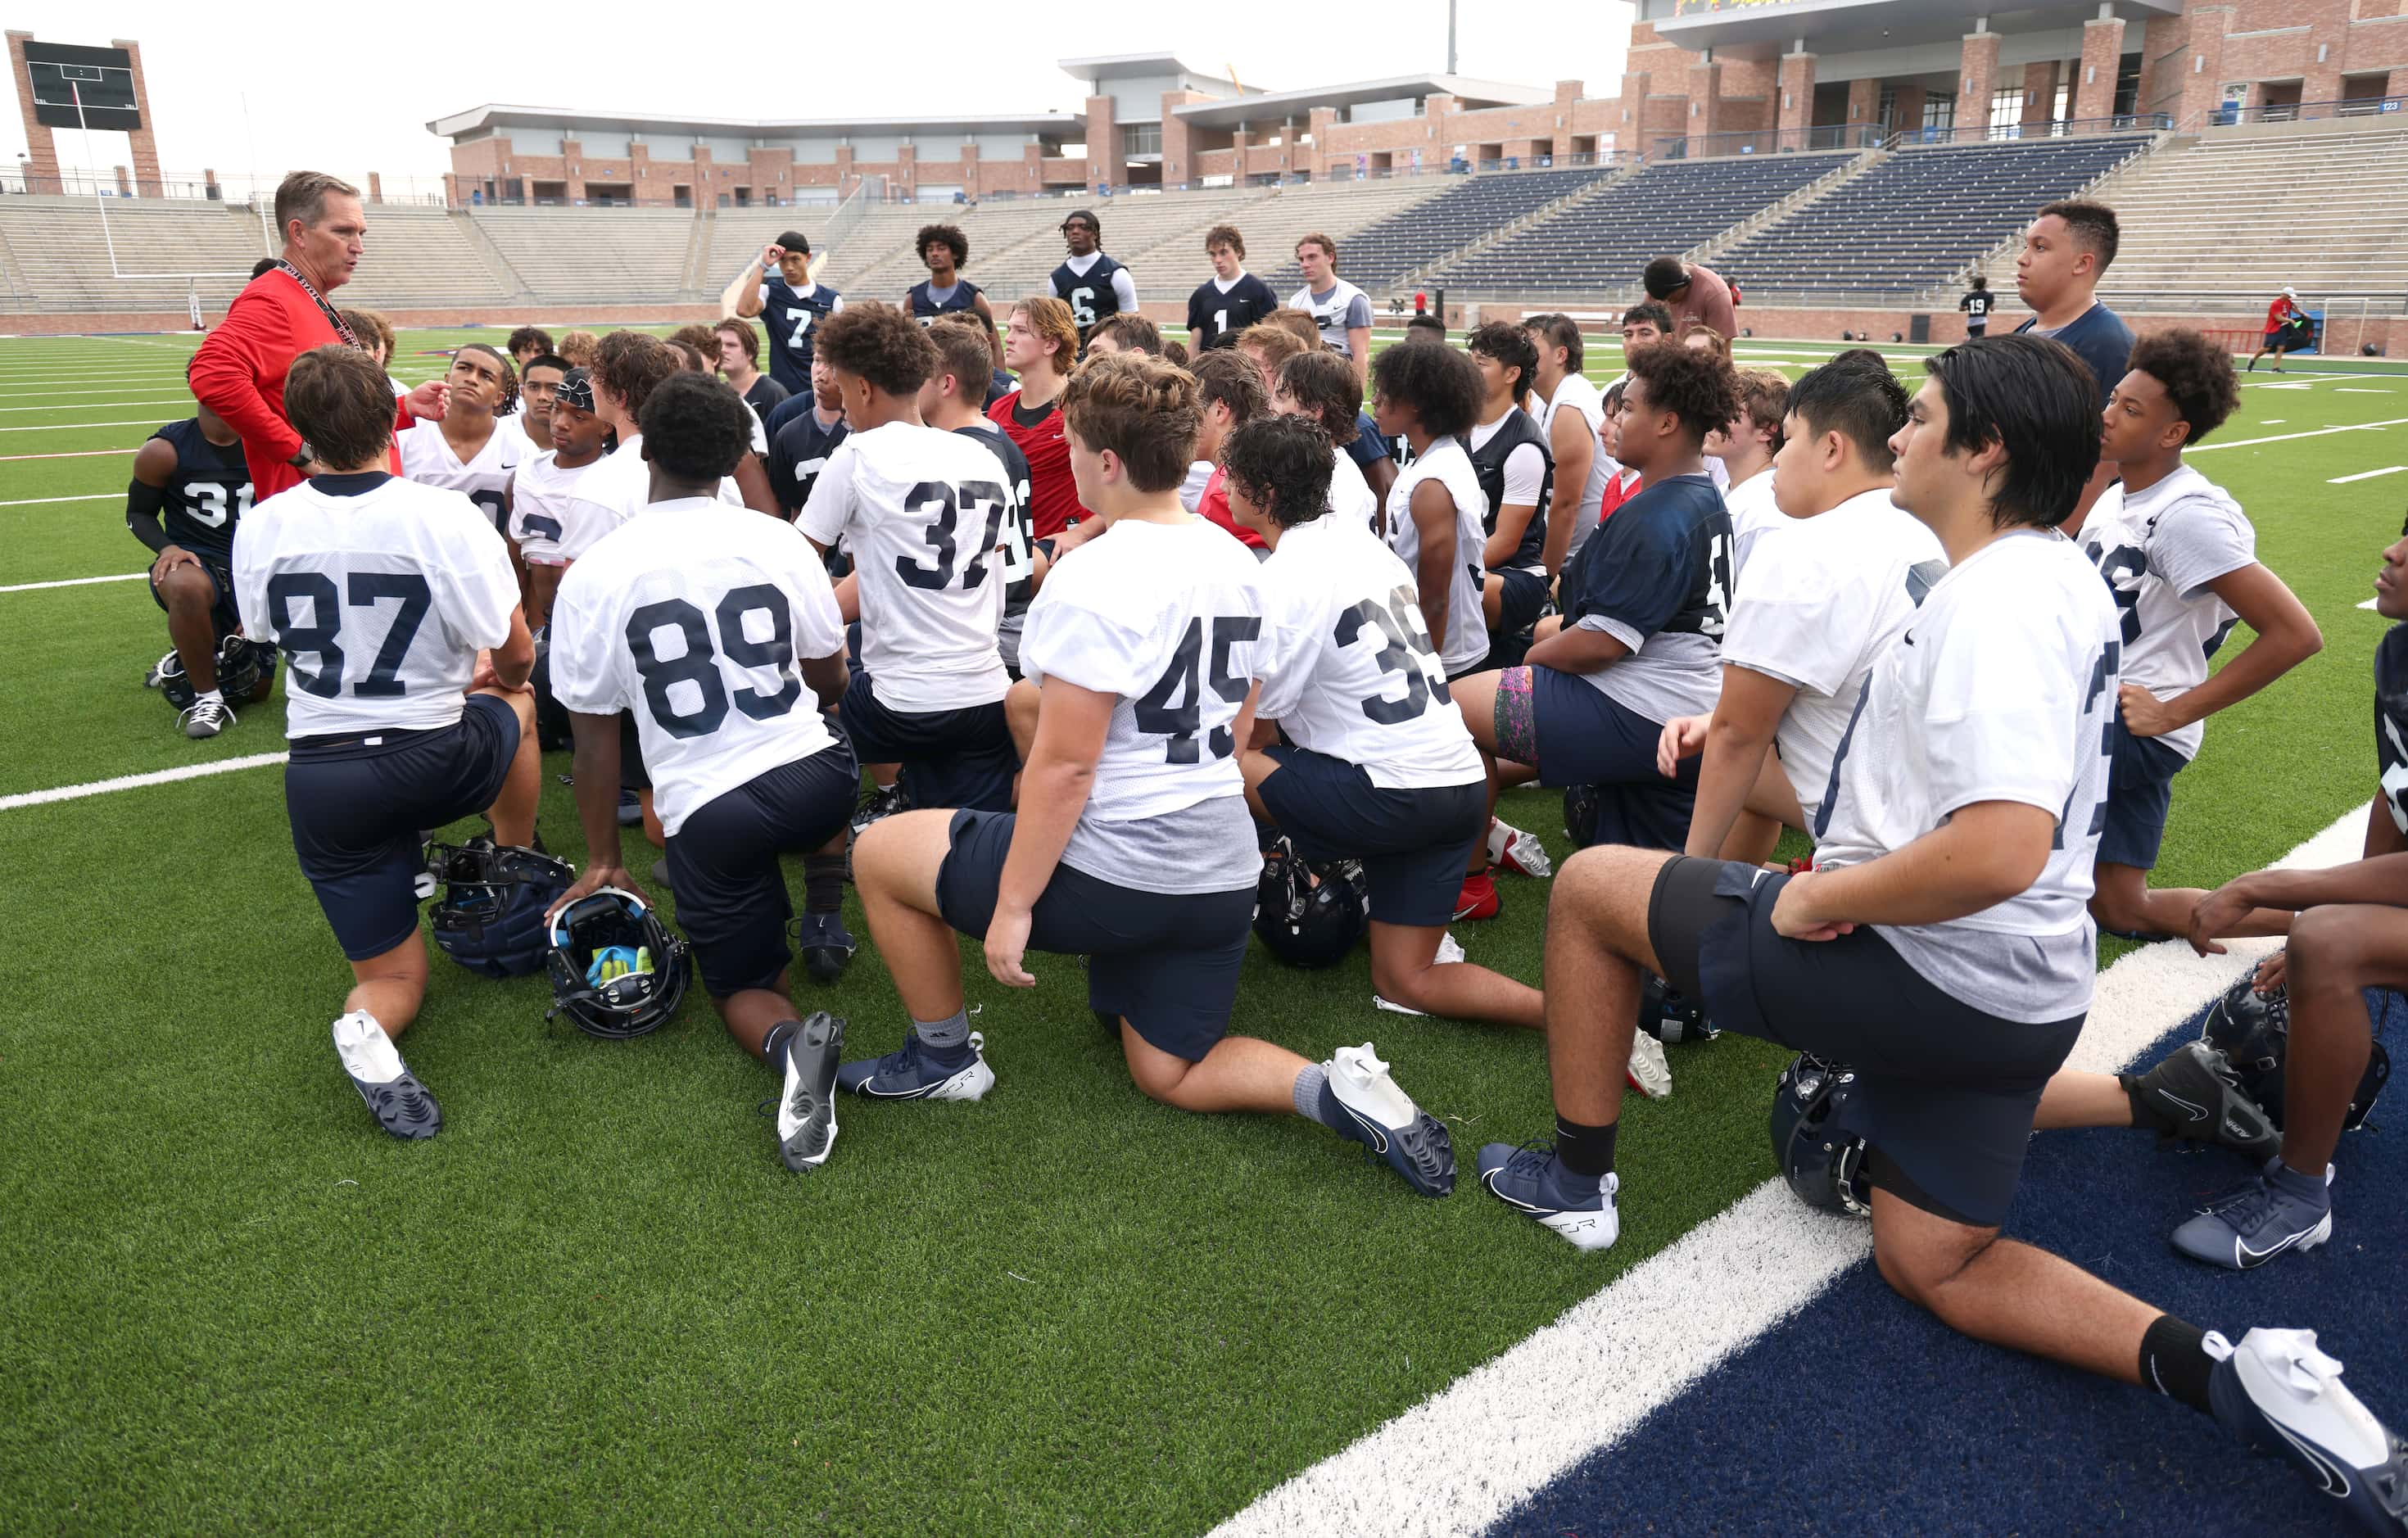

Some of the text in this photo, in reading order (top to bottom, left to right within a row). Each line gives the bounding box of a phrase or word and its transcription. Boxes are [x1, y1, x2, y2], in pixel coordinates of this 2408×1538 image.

[2383, 102, 2398, 111] 123
[786, 308, 812, 347] 7
[1071, 287, 1096, 328] 6
[1214, 310, 1227, 334] 1
[1969, 299, 1985, 314] 19
[184, 482, 255, 528] 31
[895, 480, 1007, 590] 37
[267, 572, 432, 699] 87
[1333, 584, 1452, 725] 39
[626, 583, 801, 740] 89
[1134, 616, 1262, 764] 45
